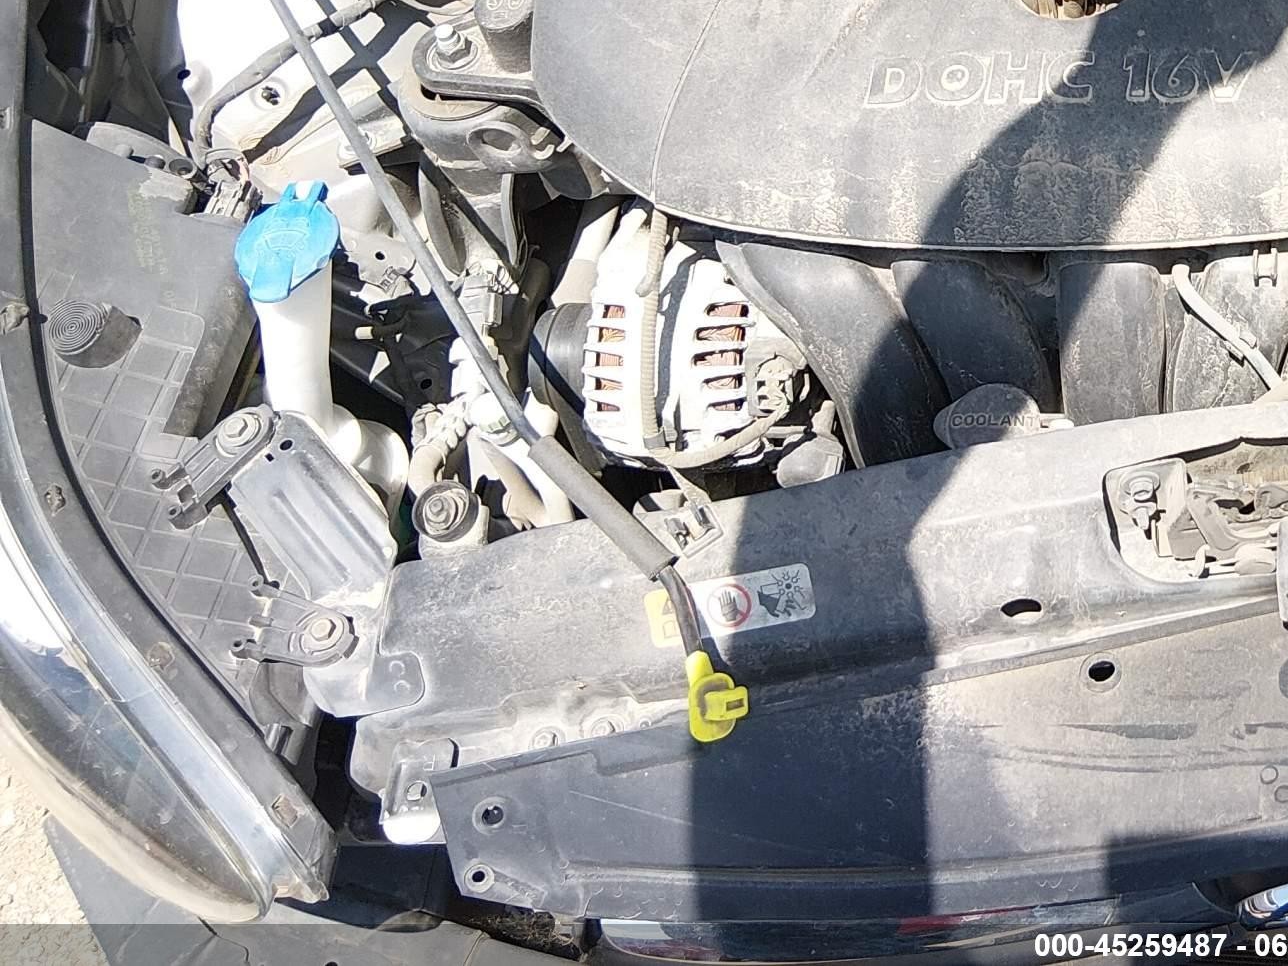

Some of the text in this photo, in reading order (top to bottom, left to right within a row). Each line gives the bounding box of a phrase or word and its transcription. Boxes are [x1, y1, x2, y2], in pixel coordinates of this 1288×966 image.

[863, 48, 1260, 109] DOHC 16V
[952, 414, 1036, 427] COOLANT
